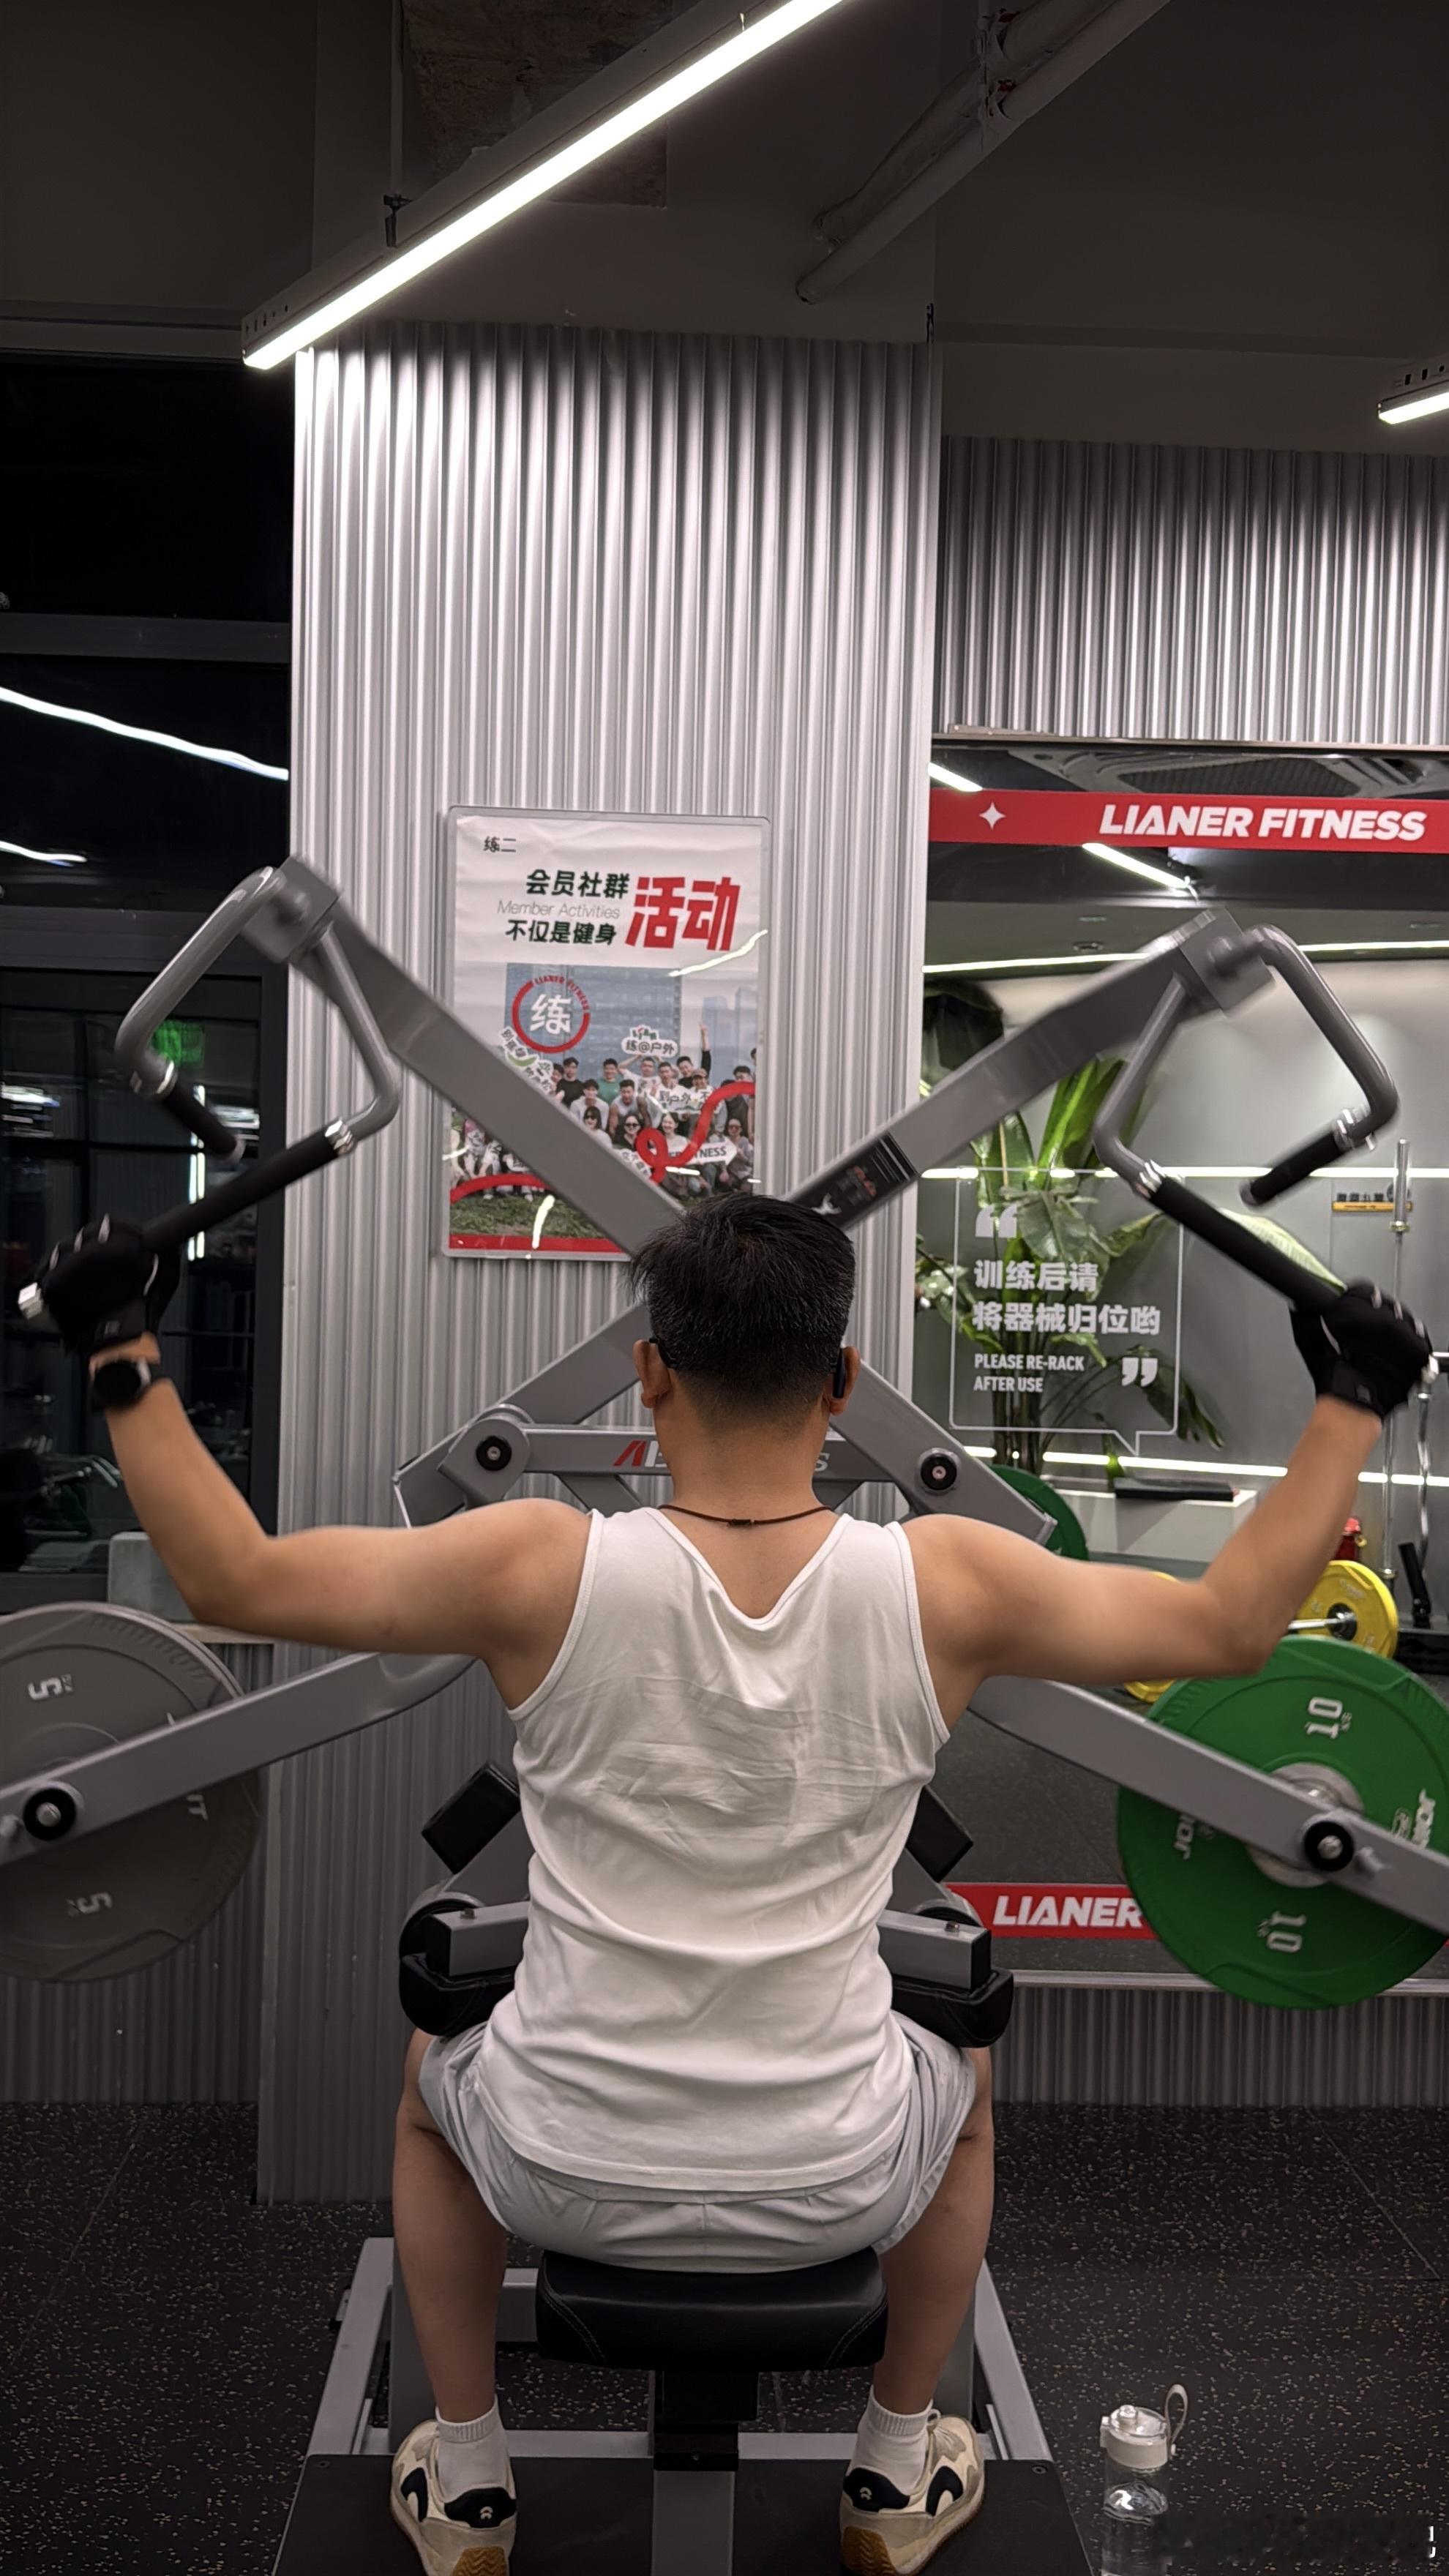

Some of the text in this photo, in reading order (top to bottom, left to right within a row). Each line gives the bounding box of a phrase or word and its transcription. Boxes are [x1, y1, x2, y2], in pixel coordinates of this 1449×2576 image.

[1099, 804, 1427, 842] LIANER FITNESS
[483, 836, 517, 853] 练二
[526, 869, 630, 899] 会员社群
[497, 900, 621, 920] Member Activities
[625, 876, 741, 951] 活动
[505, 919, 617, 946] 不仅是健身
[530, 994, 572, 1035] 练
[974, 1259, 1098, 1292] 训练后请
[973, 1301, 1161, 1335] 将器械归位哟
[974, 1354, 1085, 1371] PLEASE RE-RACK
[973, 1376, 1044, 1393] AFTER USE
[28, 1677, 63, 1701] 5
[1304, 1696, 1344, 1740] 10
[77, 1892, 113, 1914] 5
[992, 1895, 1145, 1928] LIANER
[1267, 1910, 1307, 1953] 10
